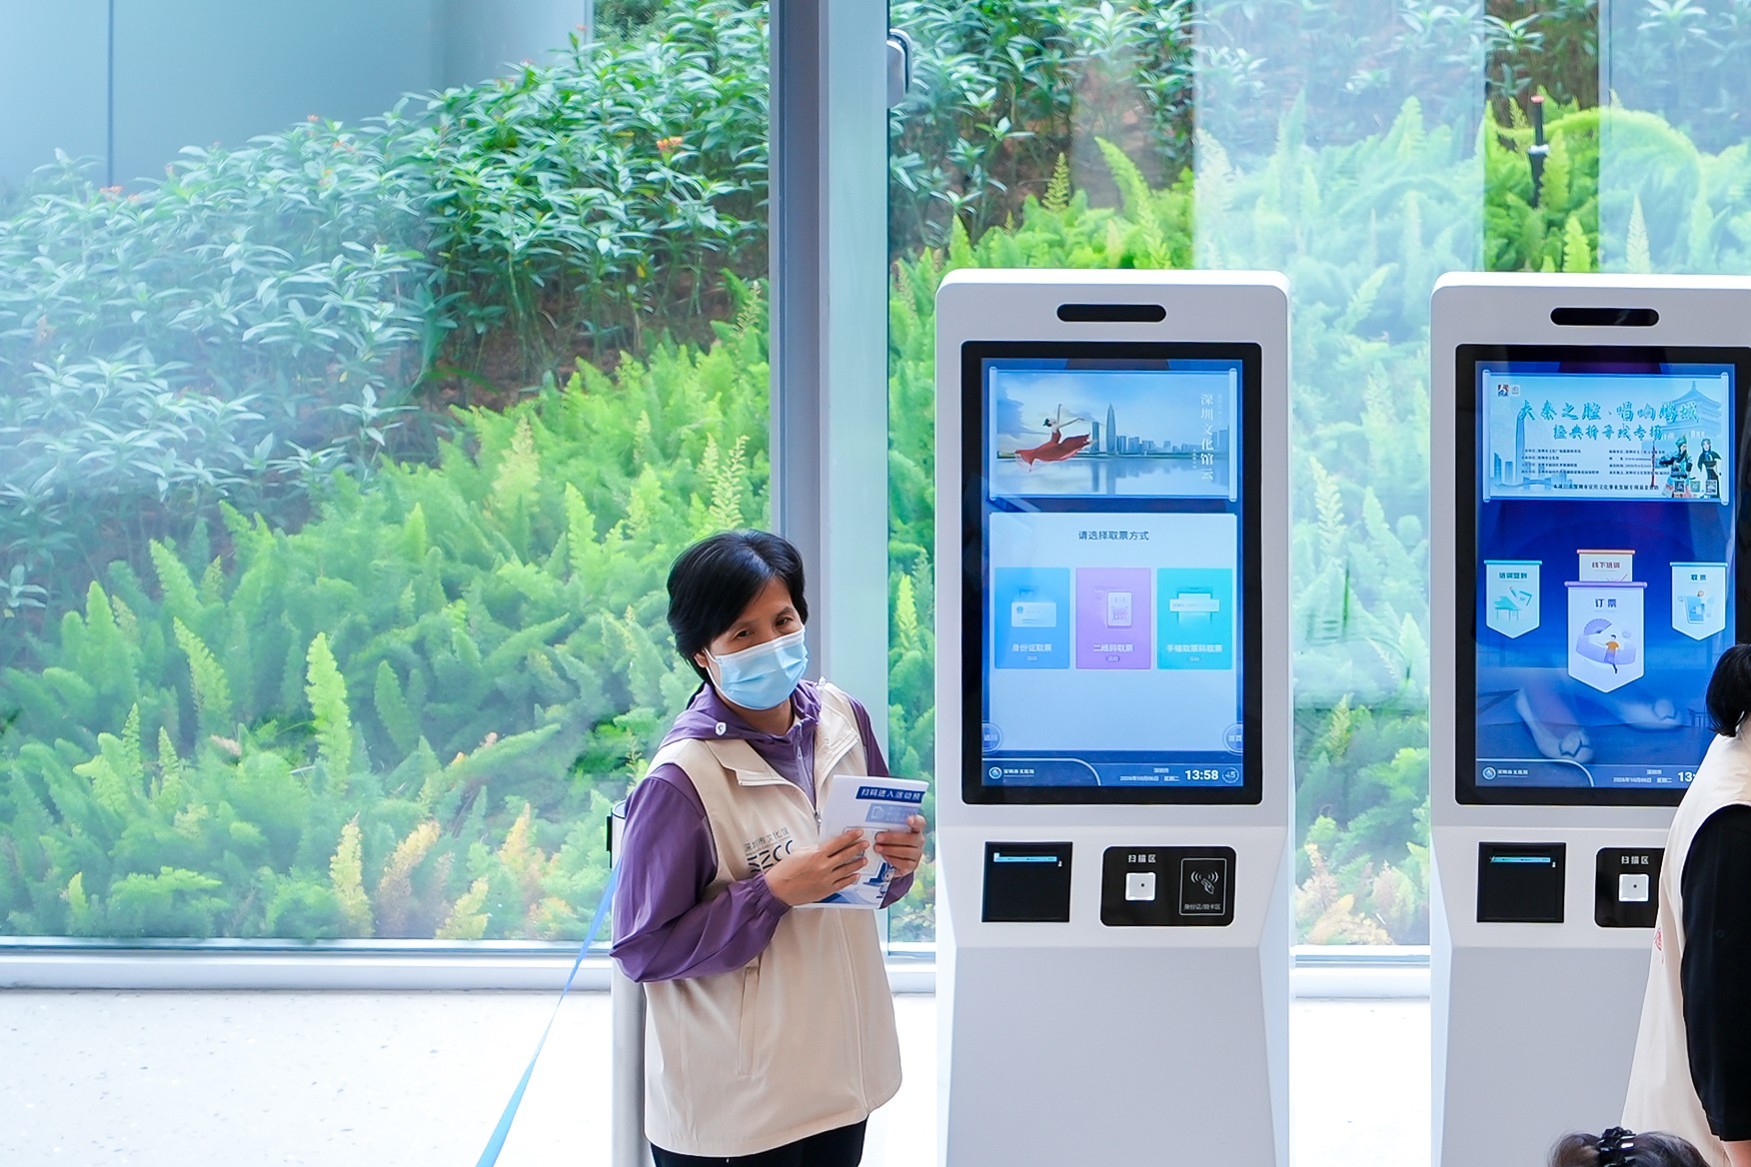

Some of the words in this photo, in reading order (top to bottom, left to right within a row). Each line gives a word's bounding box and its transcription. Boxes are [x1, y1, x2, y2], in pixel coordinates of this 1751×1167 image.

[1078, 530, 1149, 541] 请选择取票方式
[1595, 598, 1617, 608] 订票
[1184, 769, 1219, 780] 13:58
[1127, 854, 1157, 863] 扫描区
[1621, 855, 1649, 865] 扫描区
